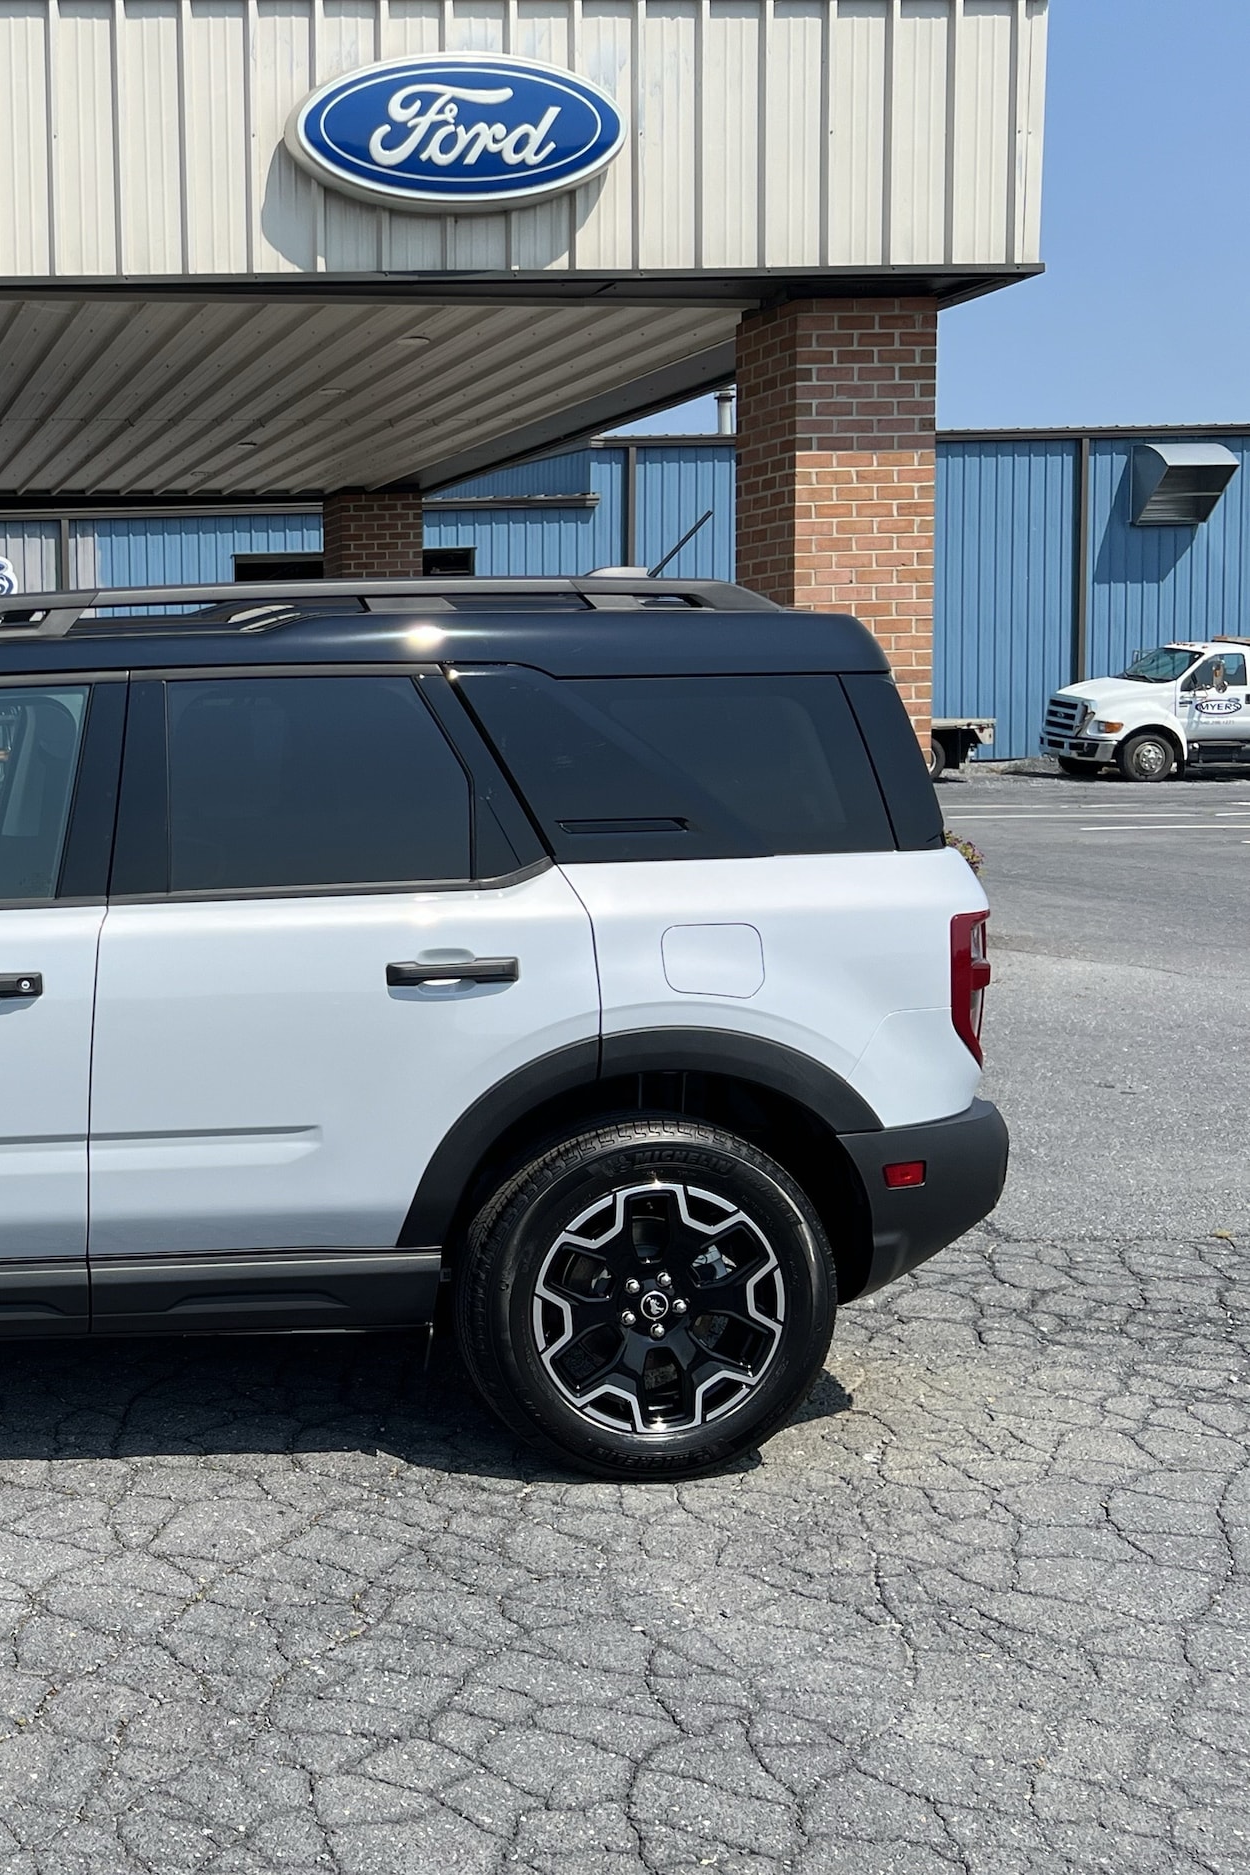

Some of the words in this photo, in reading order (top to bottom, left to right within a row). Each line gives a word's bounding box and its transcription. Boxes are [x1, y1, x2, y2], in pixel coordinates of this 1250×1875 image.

[368, 82, 562, 167] Ford
[1199, 702, 1239, 711] MYERS
[634, 1149, 732, 1174] MICHELIN
